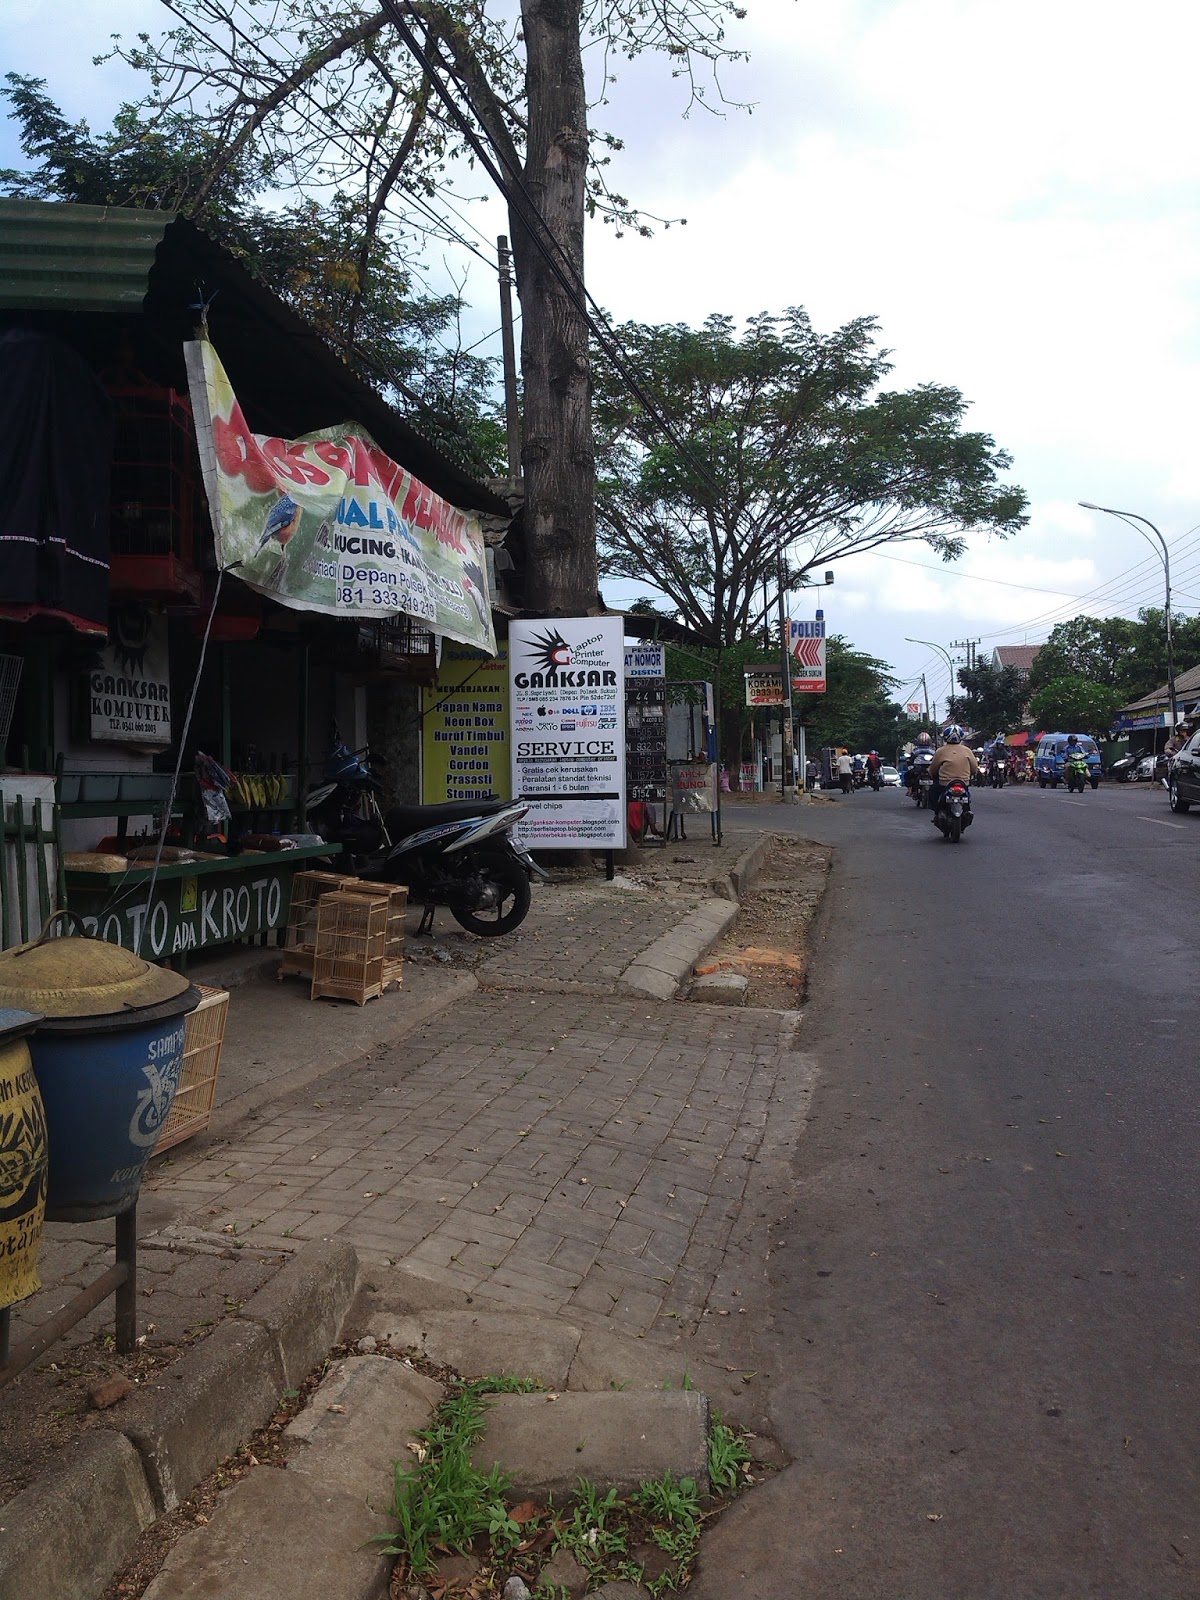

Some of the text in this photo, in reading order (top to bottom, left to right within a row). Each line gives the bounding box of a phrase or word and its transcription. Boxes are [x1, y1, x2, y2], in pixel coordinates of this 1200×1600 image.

[334, 533, 400, 560] KUCING,
[336, 587, 364, 604] 081
[372, 589, 398, 606] 333
[791, 622, 825, 638] POLISI
[569, 633, 604, 654] Laptop
[574, 650, 605, 659] Printer
[635, 654, 661, 666] NOMOR
[570, 656, 611, 667] Computer
[514, 670, 617, 689] GANKSAR
[91, 697, 170, 722] KOMPUTER
[436, 702, 502, 714] Papan Nama
[600, 704, 616, 712] IBM
[444, 716, 494, 727] Neon Box
[434, 731, 505, 741] Huruf Timbul
[450, 745, 488, 756] Vandel
[517, 740, 614, 757] SERVICE
[449, 759, 489, 770] Gordon
[560, 765, 598, 773] kerusakan
[446, 774, 492, 784] Prasasti
[522, 775, 557, 783] Peralatan
[558, 774, 586, 782] standat
[522, 784, 551, 792] Garansi
[569, 783, 590, 791] bulan
[543, 802, 563, 812] chips
[172, 922, 197, 954] ADA
[201, 877, 281, 946] KROTO
